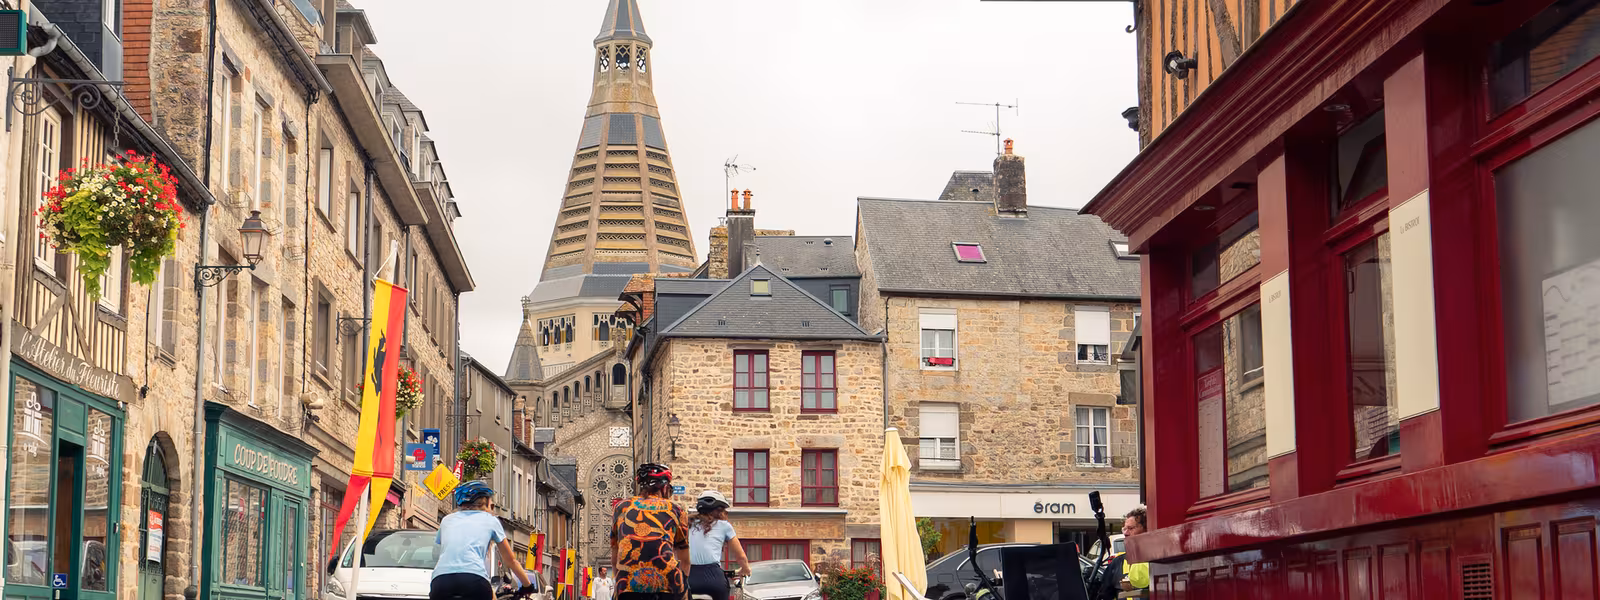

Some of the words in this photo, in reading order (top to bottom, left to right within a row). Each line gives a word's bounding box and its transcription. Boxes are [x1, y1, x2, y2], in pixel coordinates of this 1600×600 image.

[20, 330, 66, 374] l'Atelier
[66, 358, 77, 382] du
[76, 362, 120, 399] Fleuriste
[234, 443, 257, 469] COUP
[256, 452, 269, 473] DE
[270, 459, 298, 485] FOUDRE
[438, 479, 456, 498] PRESSE
